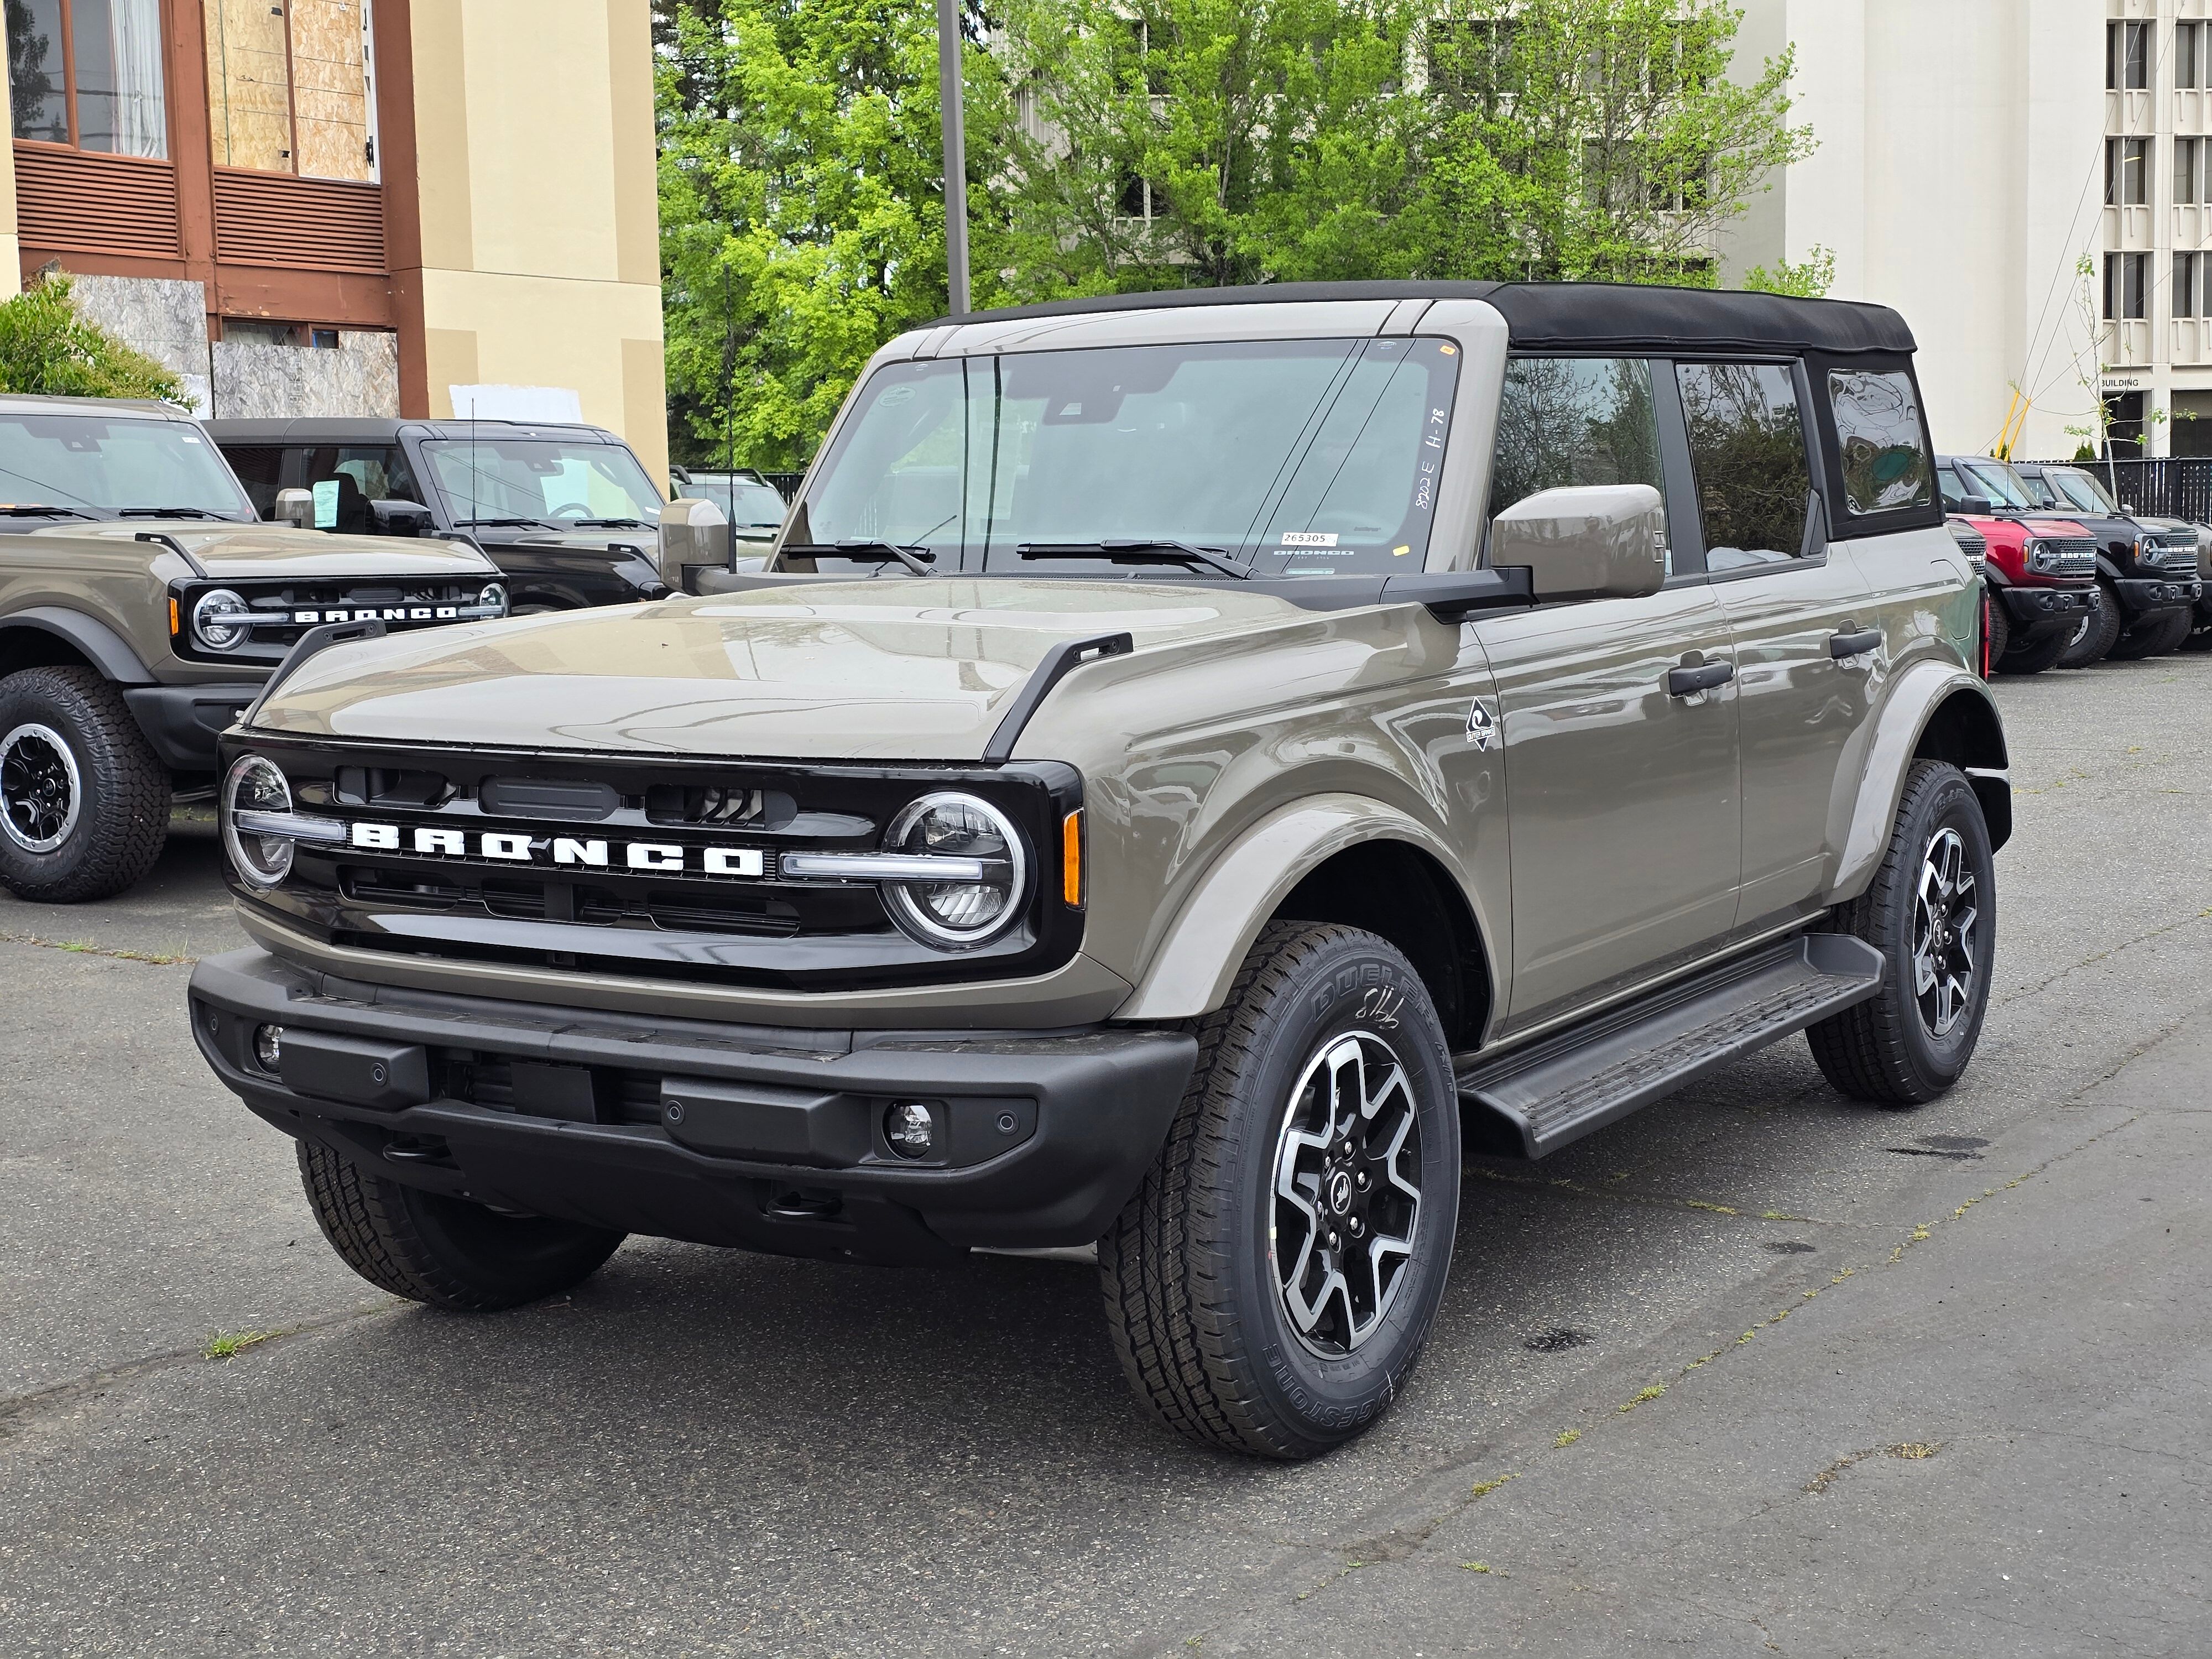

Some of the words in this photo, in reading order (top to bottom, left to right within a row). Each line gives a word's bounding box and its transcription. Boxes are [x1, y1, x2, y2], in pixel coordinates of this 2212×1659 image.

[295, 607, 456, 623] BRONCO
[352, 822, 764, 877] BRONCO
[1311, 963, 1436, 1031] DUELER
